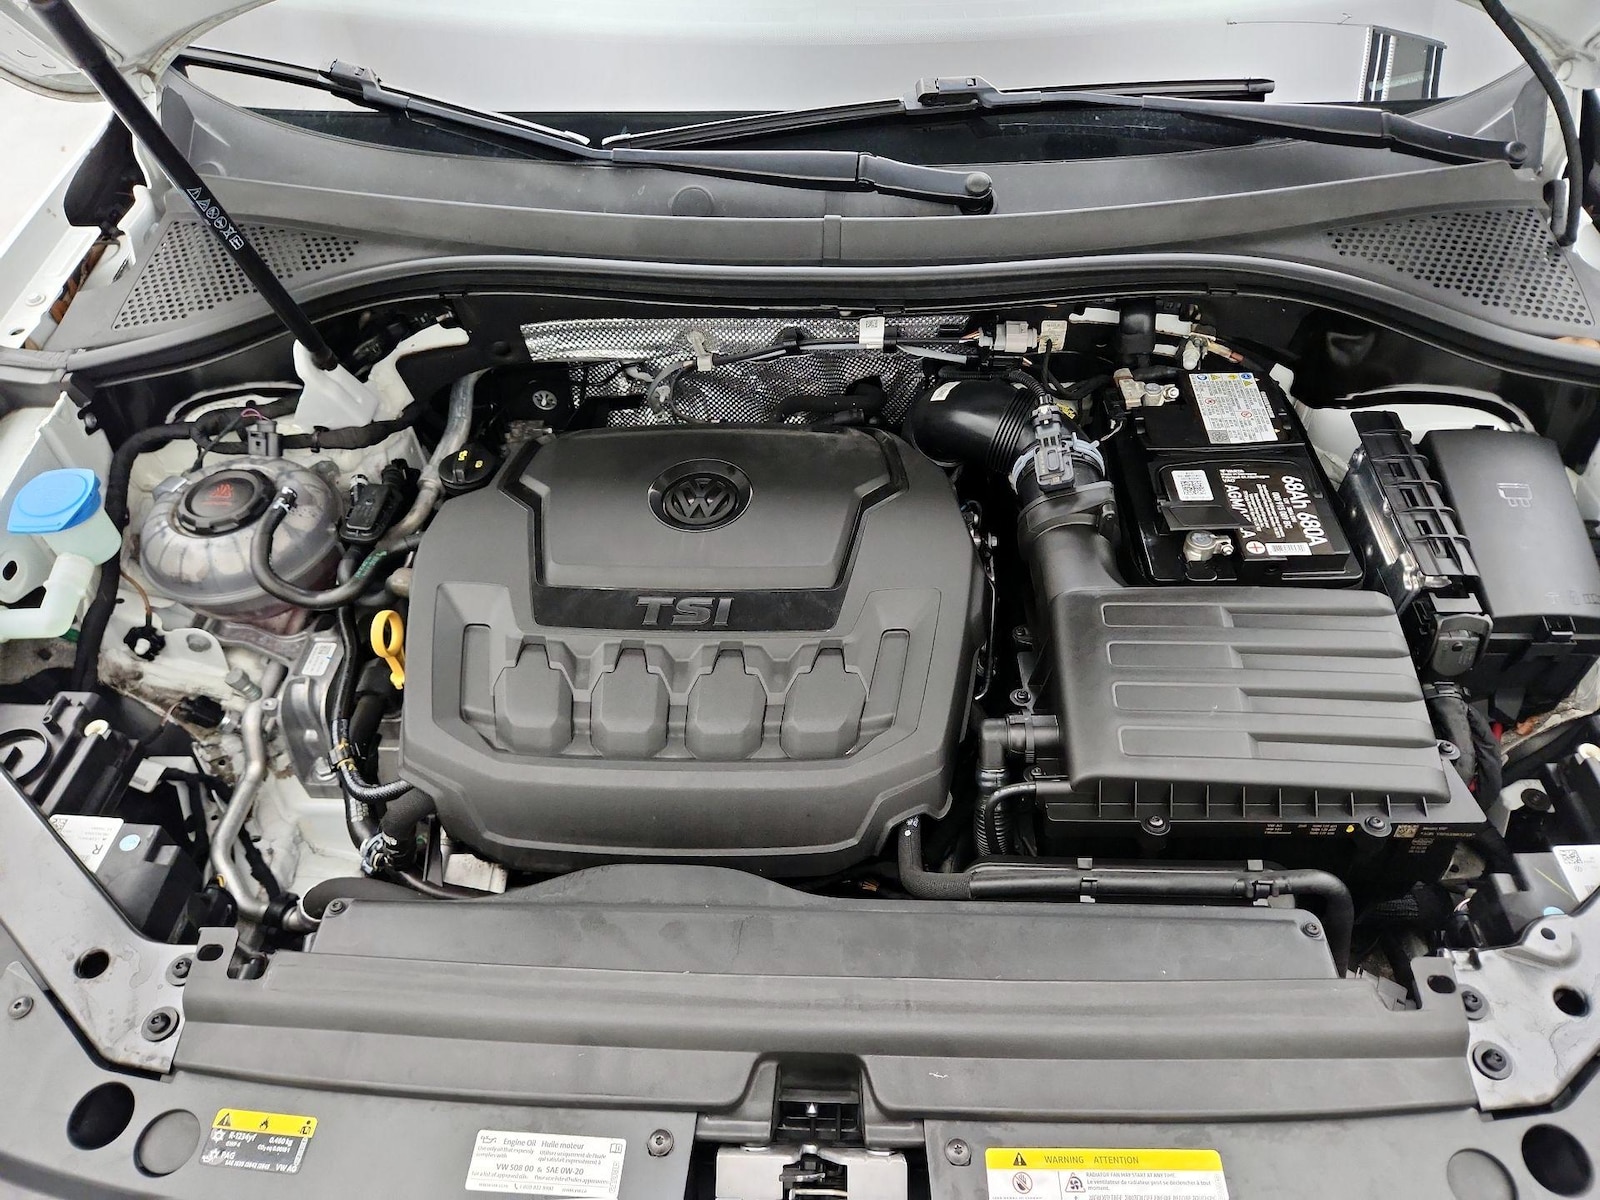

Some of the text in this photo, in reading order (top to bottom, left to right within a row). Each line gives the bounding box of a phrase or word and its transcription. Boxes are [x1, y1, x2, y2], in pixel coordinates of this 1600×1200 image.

[1281, 475, 1312, 510] 68Ah
[1297, 511, 1328, 547] 680A
[635, 596, 734, 627] TSI
[504, 1138, 526, 1147] Engine
[542, 1140, 584, 1150] Huile moteur
[221, 1150, 236, 1160] PAG
[1044, 1156, 1140, 1164] WARNING ATTENTION
[546, 1166, 558, 1174] SAE
[560, 1167, 584, 1175] 0W-20
